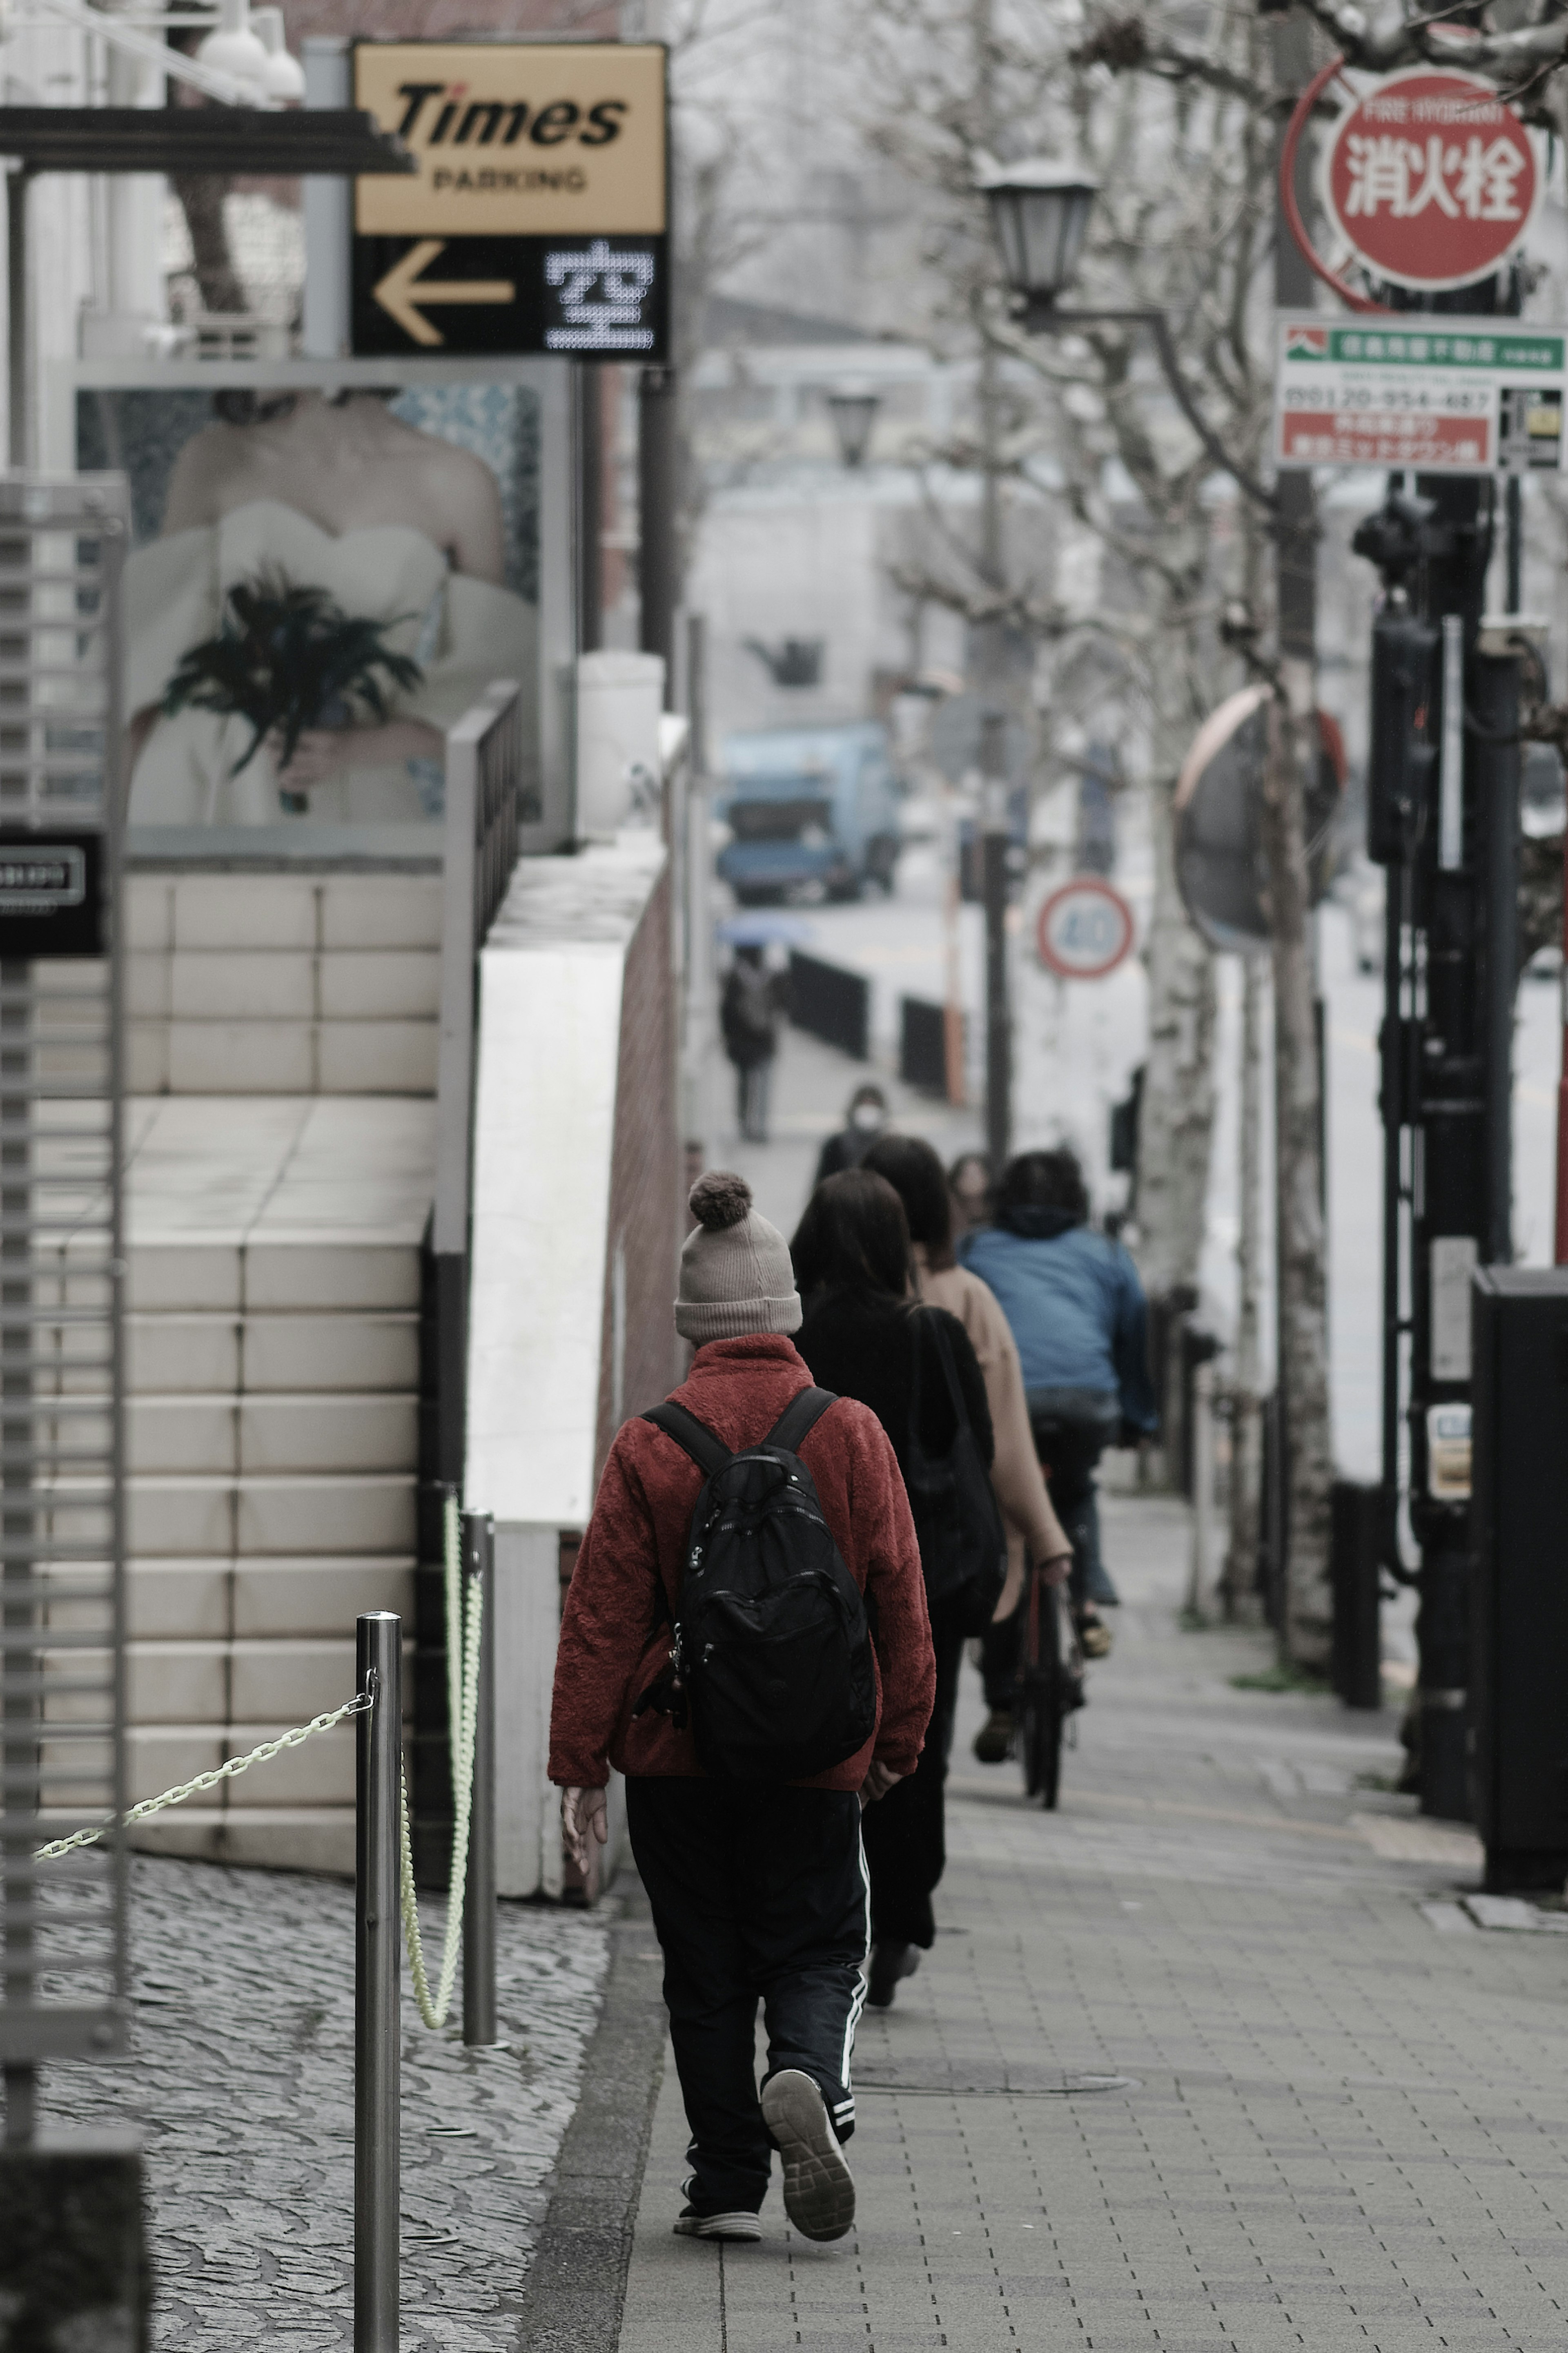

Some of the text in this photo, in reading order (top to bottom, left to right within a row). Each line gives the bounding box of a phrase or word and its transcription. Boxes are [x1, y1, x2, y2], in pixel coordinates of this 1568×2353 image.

[397, 83, 628, 146] Times
[432, 168, 588, 194] PARKING
[1345, 134, 1526, 221] 消火栓
[545, 239, 654, 350] 空
